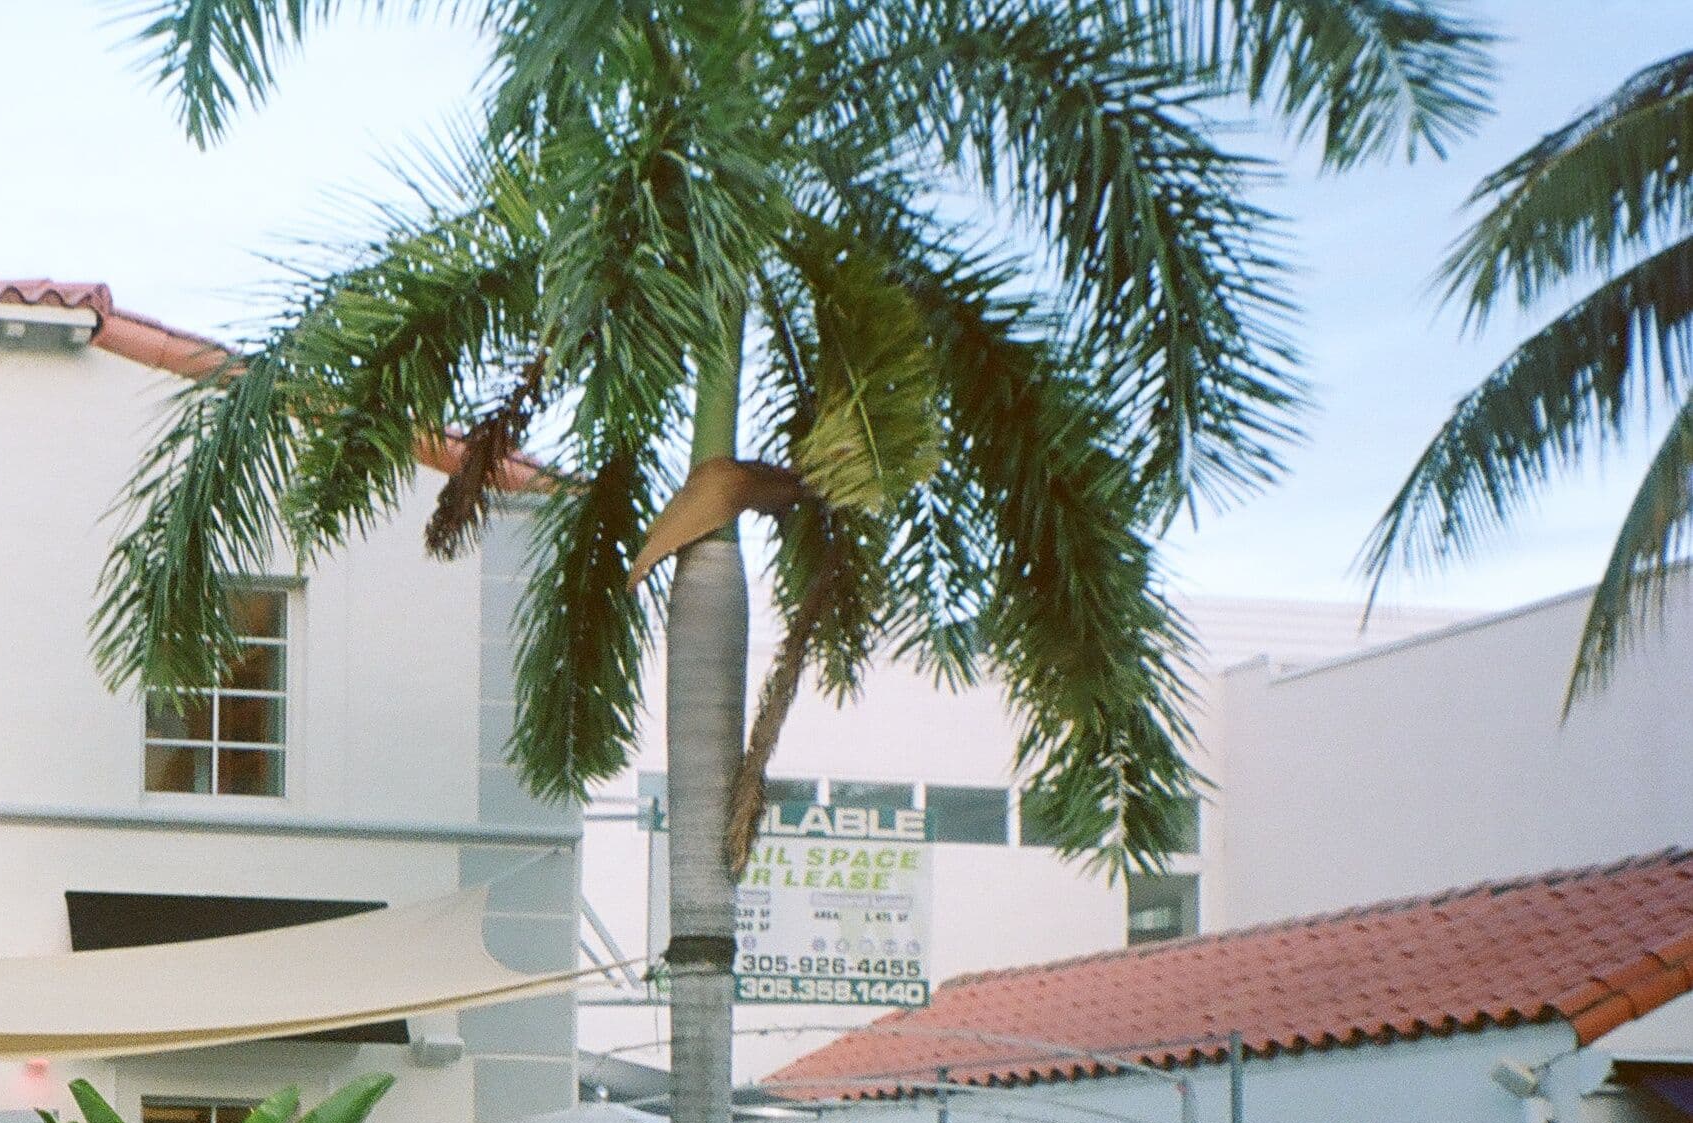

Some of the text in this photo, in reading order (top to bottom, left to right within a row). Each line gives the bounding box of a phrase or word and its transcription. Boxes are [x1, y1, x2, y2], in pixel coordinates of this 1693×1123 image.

[759, 804, 926, 840] ILABLE
[806, 847, 922, 871] SPACE
[783, 867, 892, 890] LEASE
[742, 954, 921, 977] 305-926-4455
[740, 977, 926, 1006] 305.358.1440
